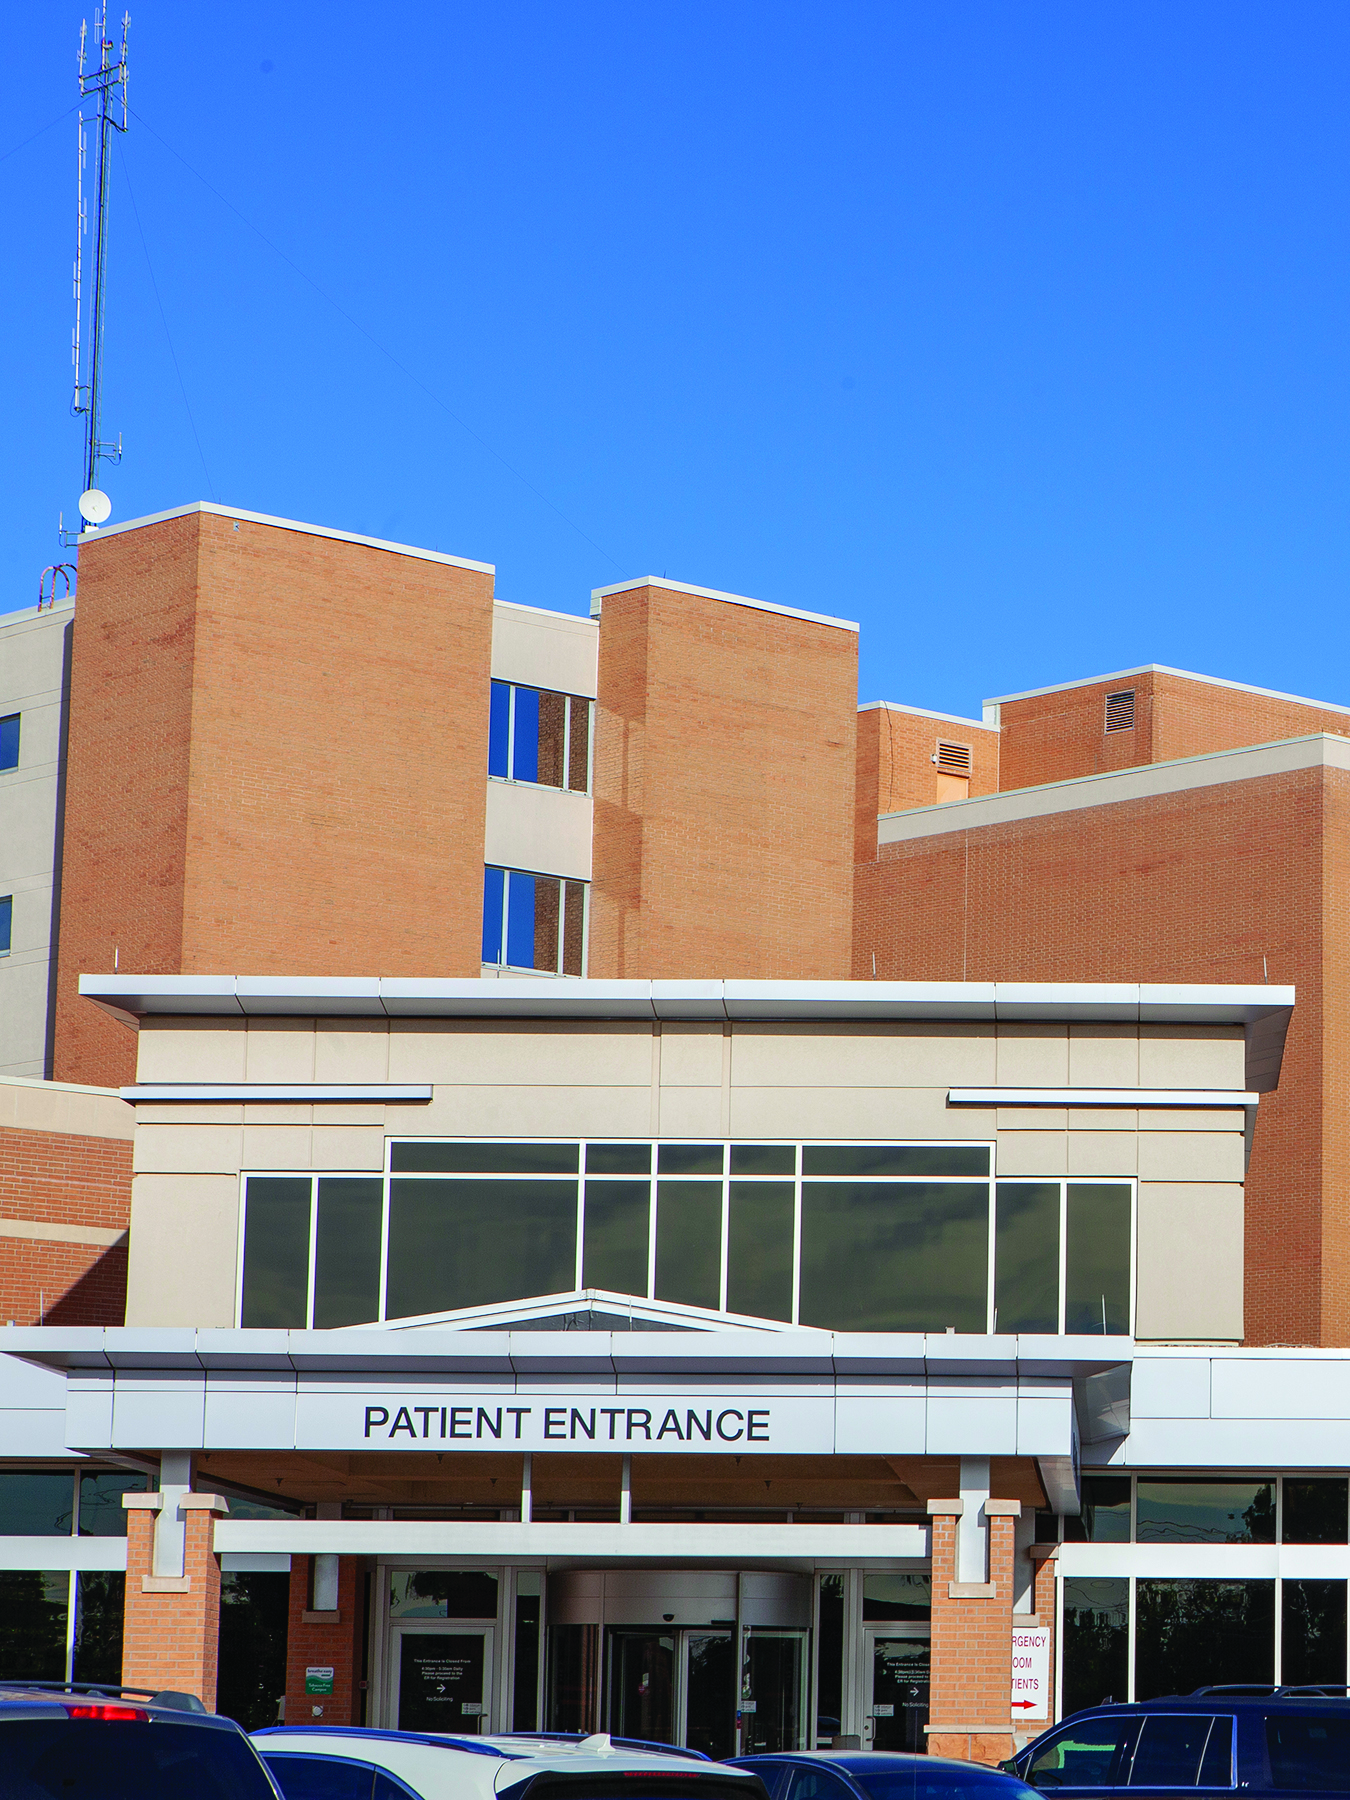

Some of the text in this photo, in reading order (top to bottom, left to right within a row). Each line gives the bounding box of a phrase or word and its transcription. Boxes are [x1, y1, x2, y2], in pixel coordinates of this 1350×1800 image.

[364, 1407, 770, 1442] PATIENT ENTRANCE
[1012, 1635, 1046, 1648] RGENCY
[1012, 1656, 1032, 1669] OOM
[1011, 1678, 1039, 1690] TIENTS
